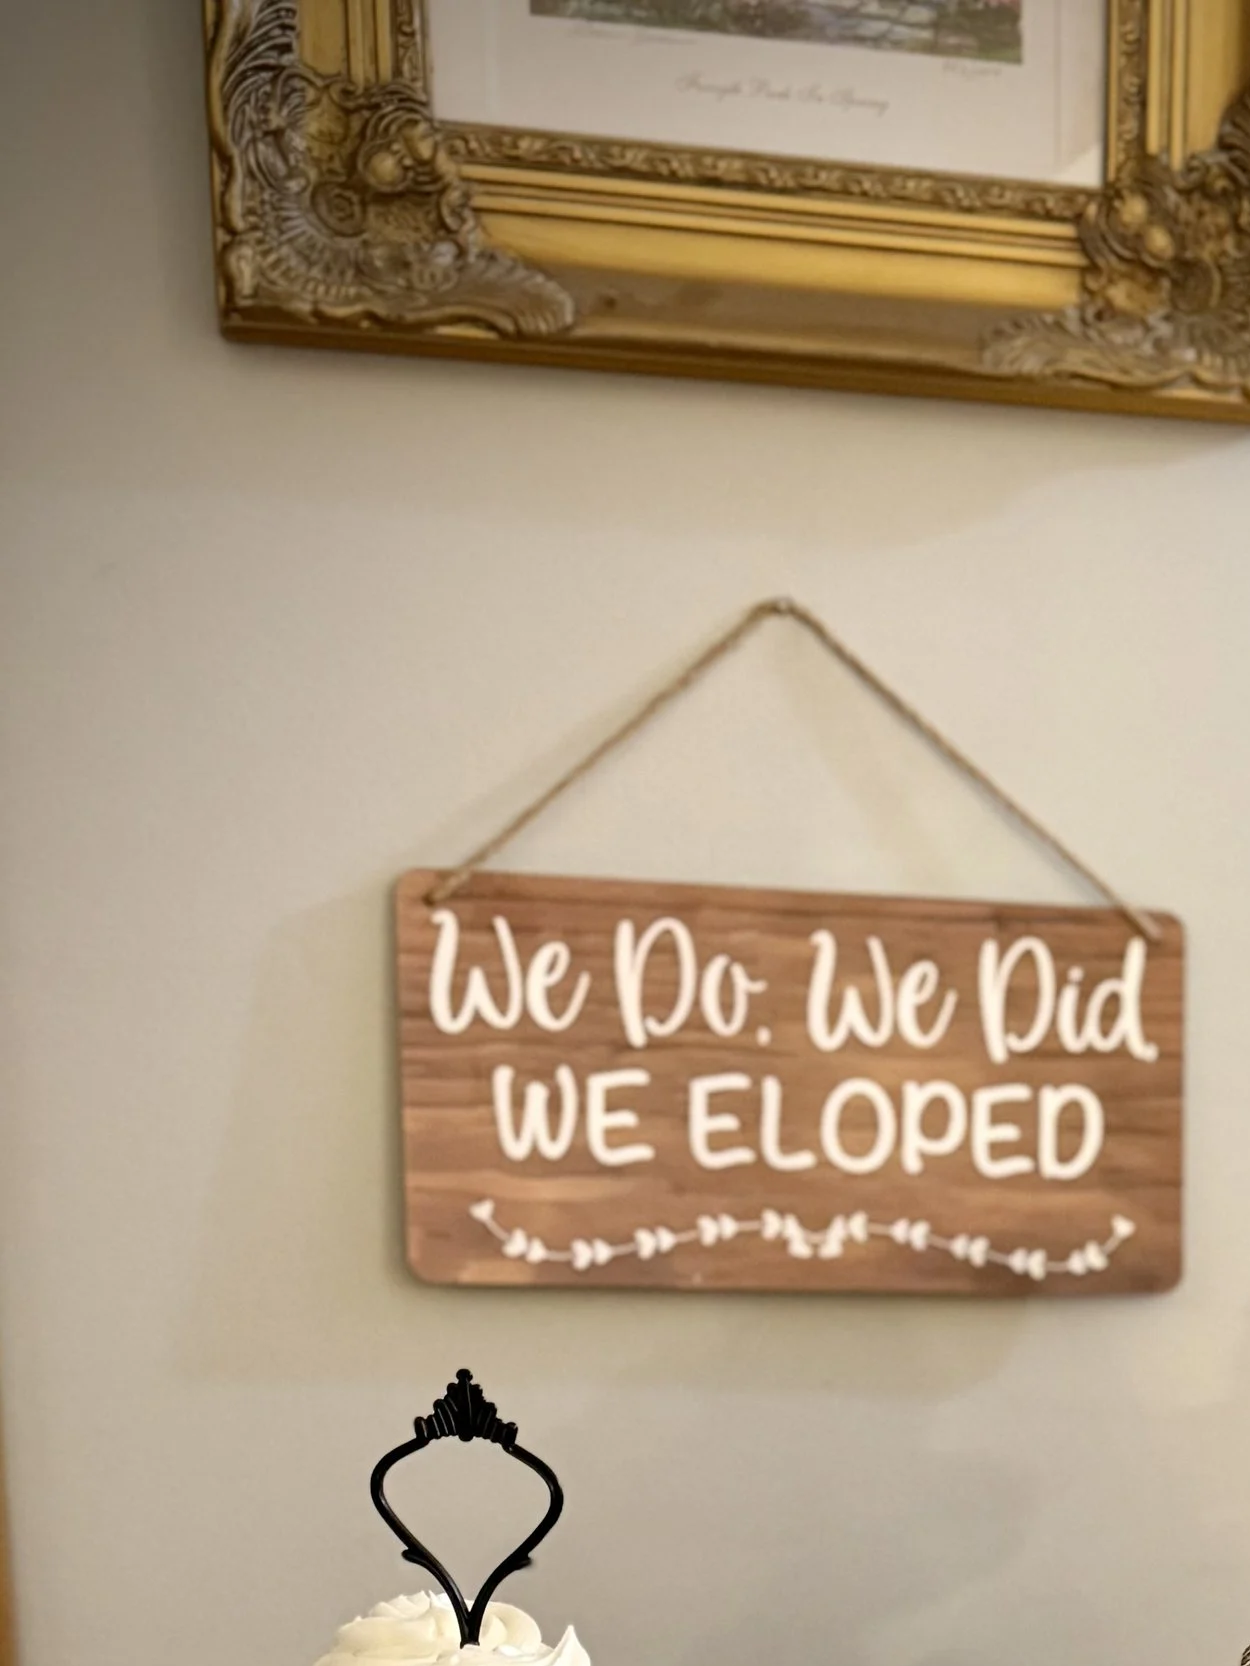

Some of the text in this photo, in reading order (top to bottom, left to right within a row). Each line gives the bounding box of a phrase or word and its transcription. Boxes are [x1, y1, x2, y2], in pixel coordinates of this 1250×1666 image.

[429, 909, 591, 1034] We
[807, 930, 958, 1052] We
[978, 936, 1160, 1064] Did
[492, 1065, 1105, 1180] WE ELOPED
